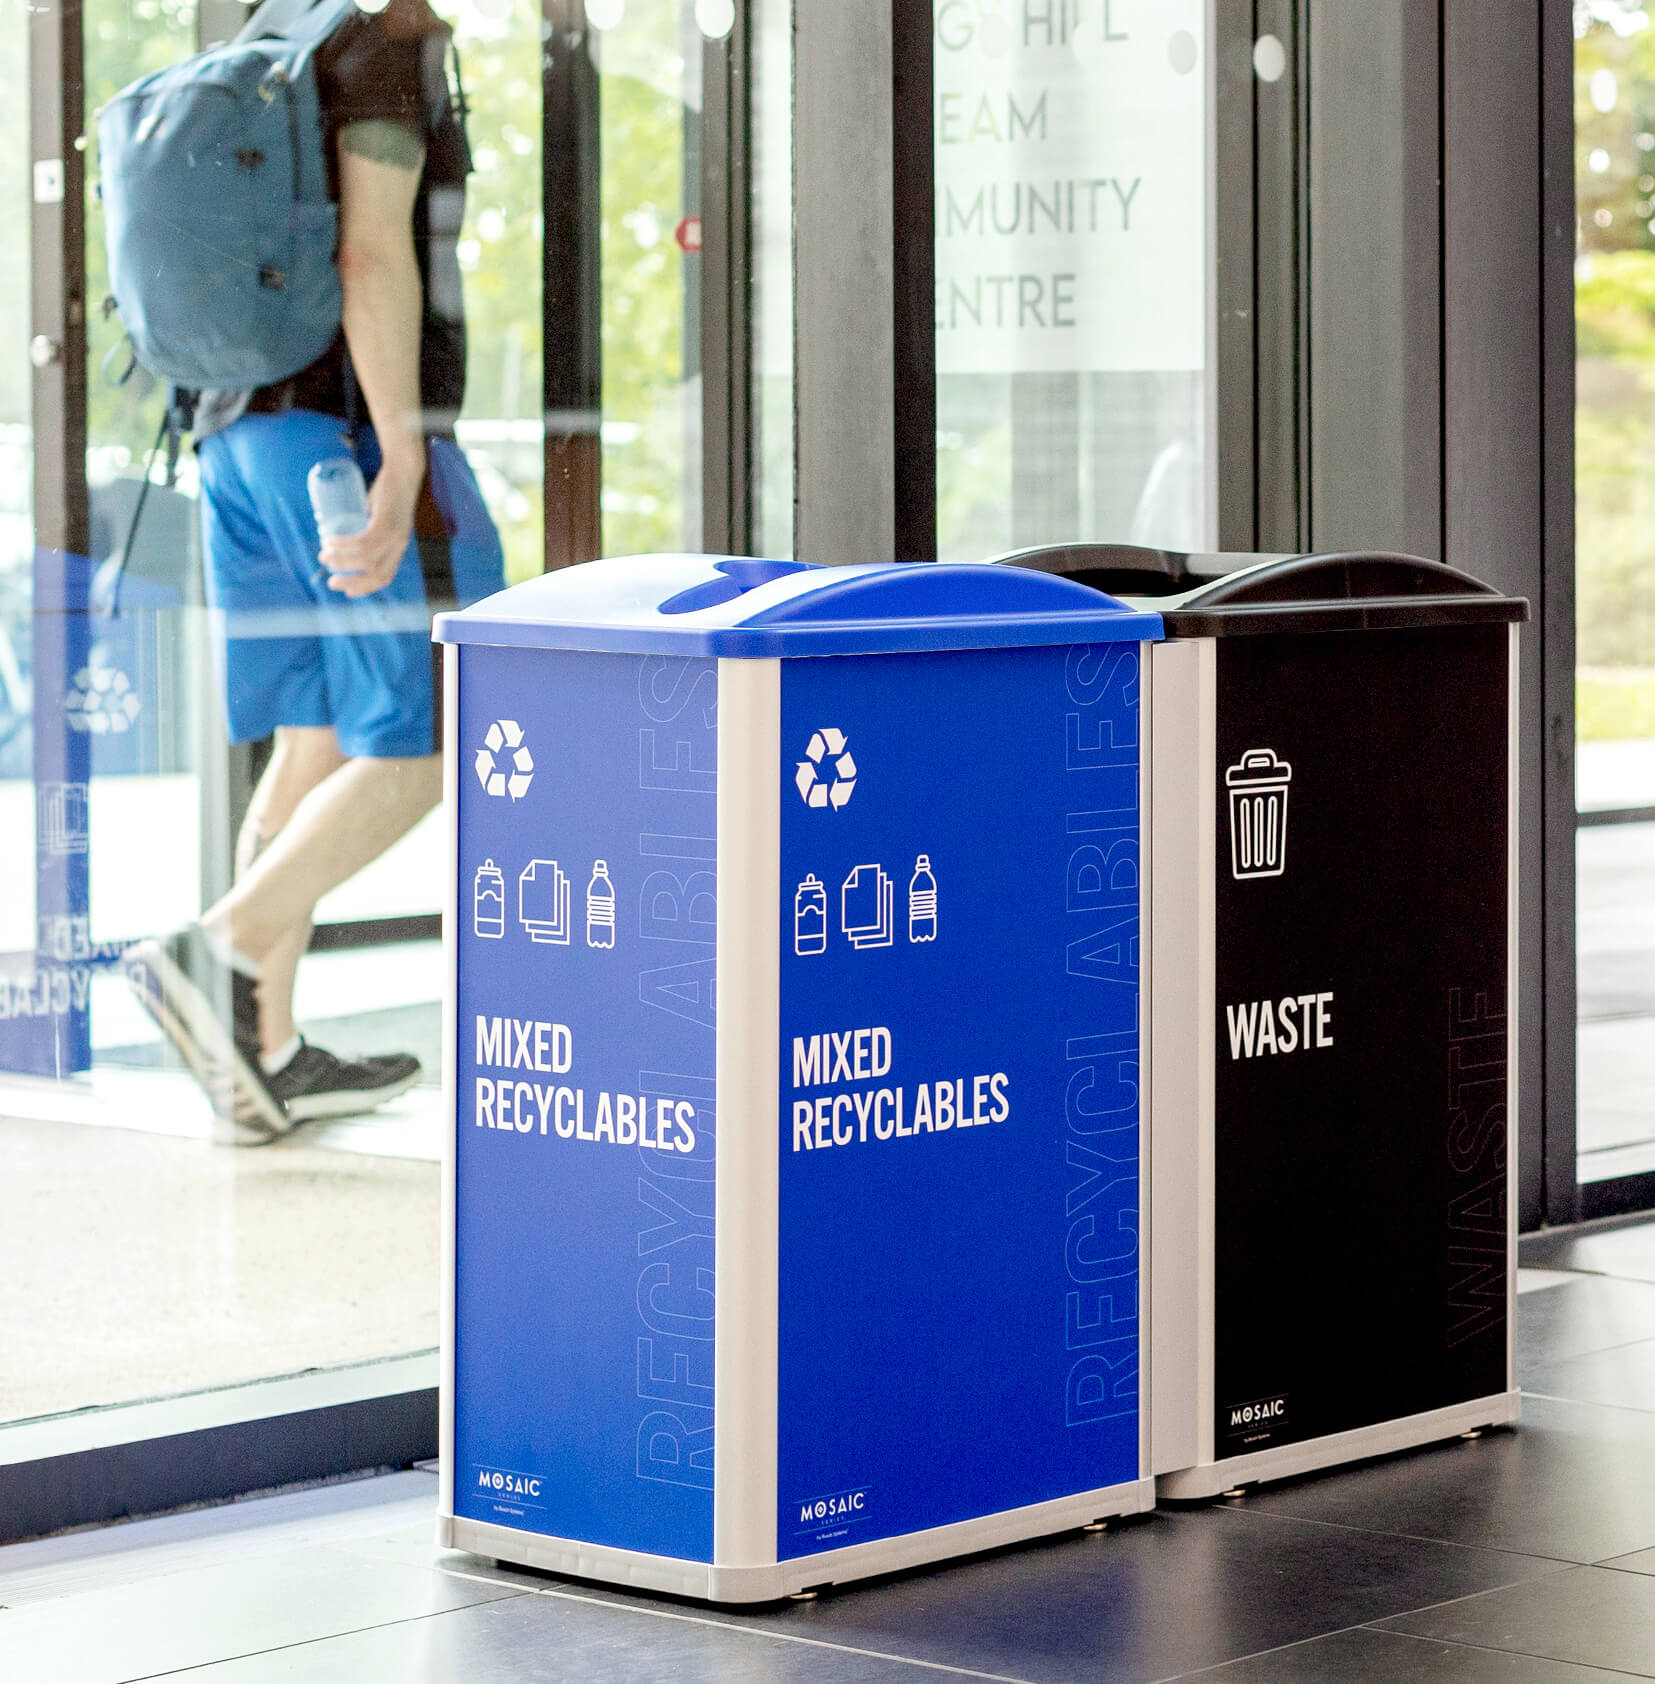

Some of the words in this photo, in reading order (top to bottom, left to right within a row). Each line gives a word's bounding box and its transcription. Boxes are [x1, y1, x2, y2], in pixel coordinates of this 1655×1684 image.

[934, 177, 1141, 237] MUNITY
[476, 1015, 572, 1074] MIXED
[1227, 992, 1333, 1060] WASTE
[793, 1027, 892, 1088] MIXED
[476, 1077, 695, 1153] RECYCLABLES
[793, 1072, 1010, 1152] RECYCLABLES
[1447, 987, 1506, 1348] WASTE
[1231, 1400, 1284, 1426] MOSAIC
[479, 1470, 540, 1497] MOSAIC
[801, 1492, 864, 1522] MOSAIC
